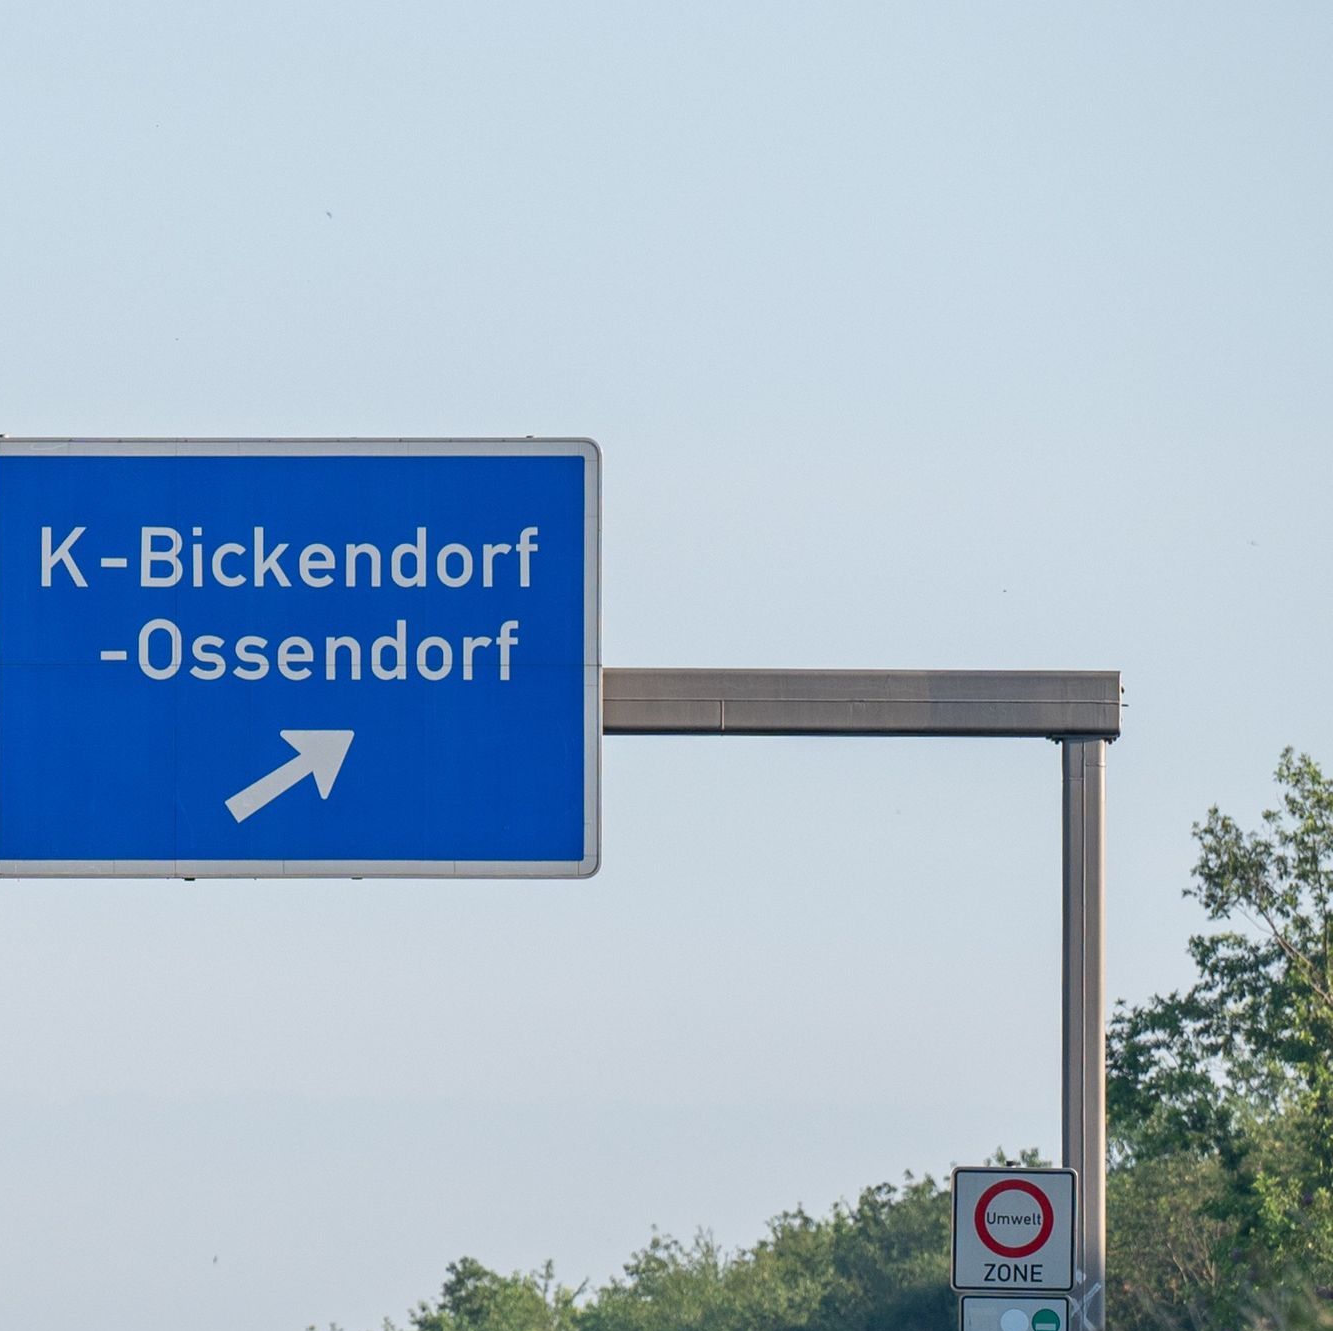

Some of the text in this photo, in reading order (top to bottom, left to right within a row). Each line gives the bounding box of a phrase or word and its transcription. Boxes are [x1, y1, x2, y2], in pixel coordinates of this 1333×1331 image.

[41, 526, 539, 588] K-Bickendorf
[100, 618, 519, 681] -Ossendorf
[986, 1212, 1041, 1226] Umwelt
[984, 1263, 1043, 1283] ZONE
